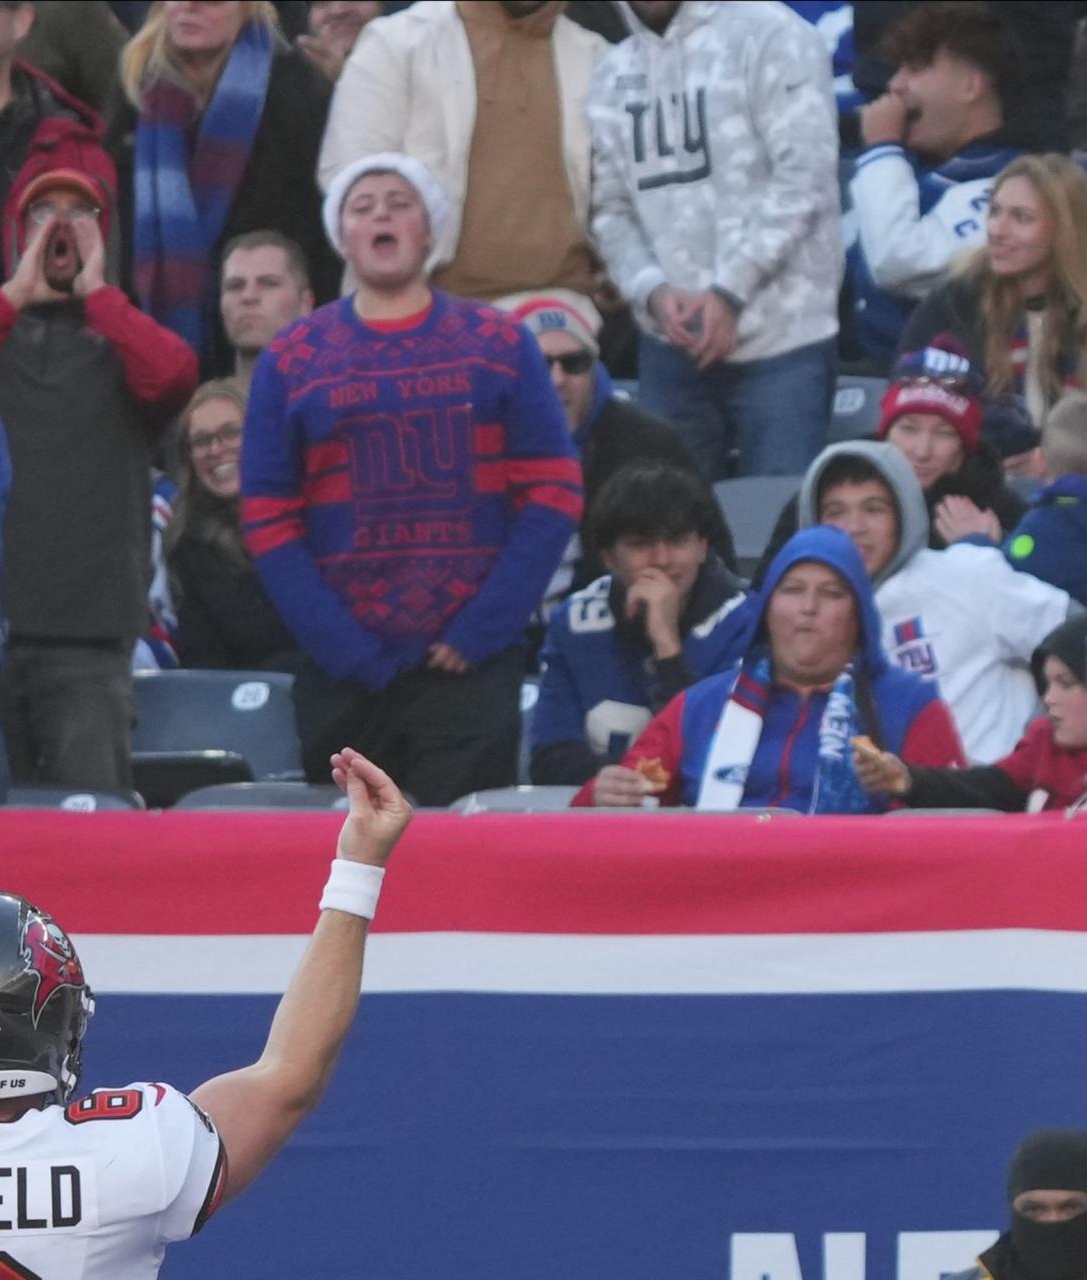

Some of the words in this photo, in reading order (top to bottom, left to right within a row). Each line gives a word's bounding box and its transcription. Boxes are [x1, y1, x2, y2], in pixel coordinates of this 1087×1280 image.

[398, 372, 472, 398] YORK
[353, 521, 472, 548] GIANTS
[818, 691, 853, 759] NEW
[10, 1078, 26, 1089] US
